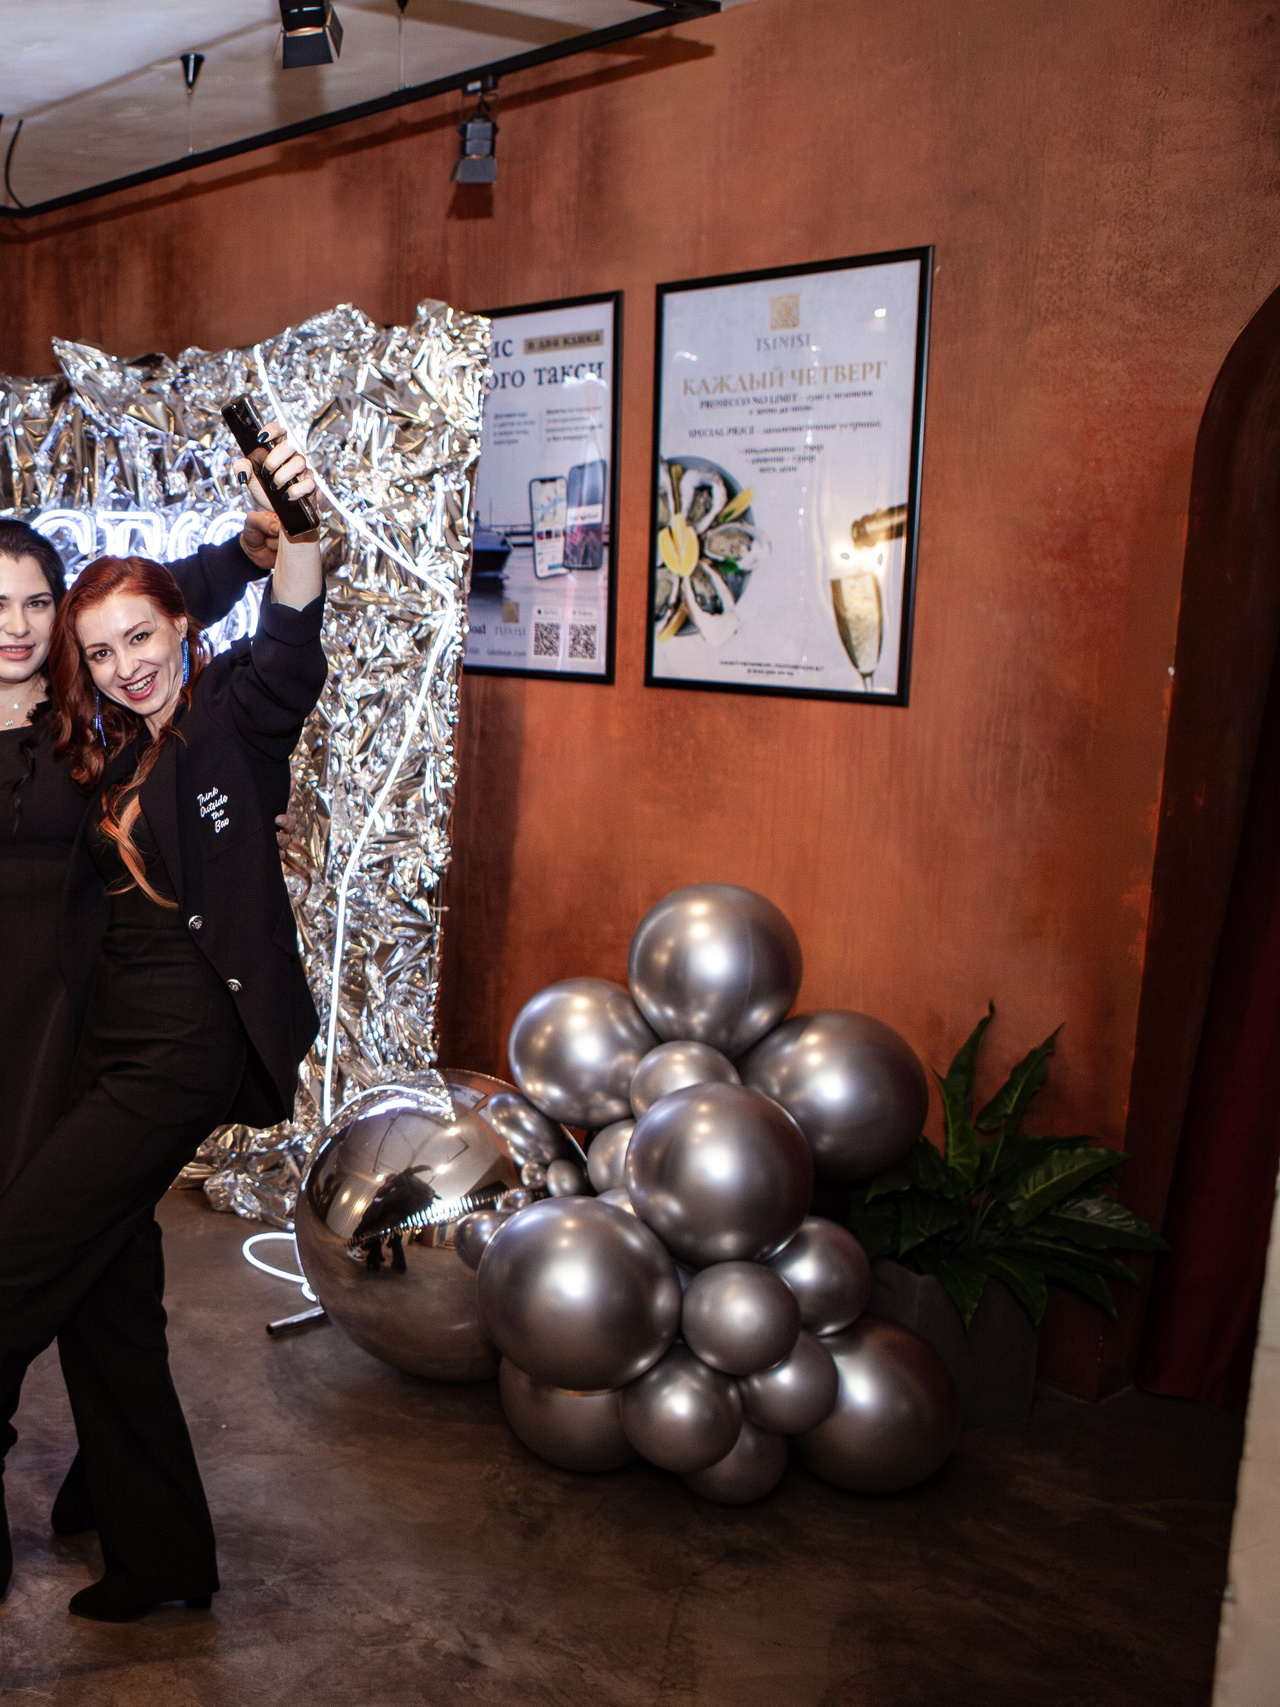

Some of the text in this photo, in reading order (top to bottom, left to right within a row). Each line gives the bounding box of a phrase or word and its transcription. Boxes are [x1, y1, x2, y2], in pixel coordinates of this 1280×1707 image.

[682, 360, 888, 398] КАЖДЫЙ ЧЕТВЕРГ
[197, 787, 218, 806] Think
[200, 794, 228, 818] Outside
[211, 809, 224, 820] the
